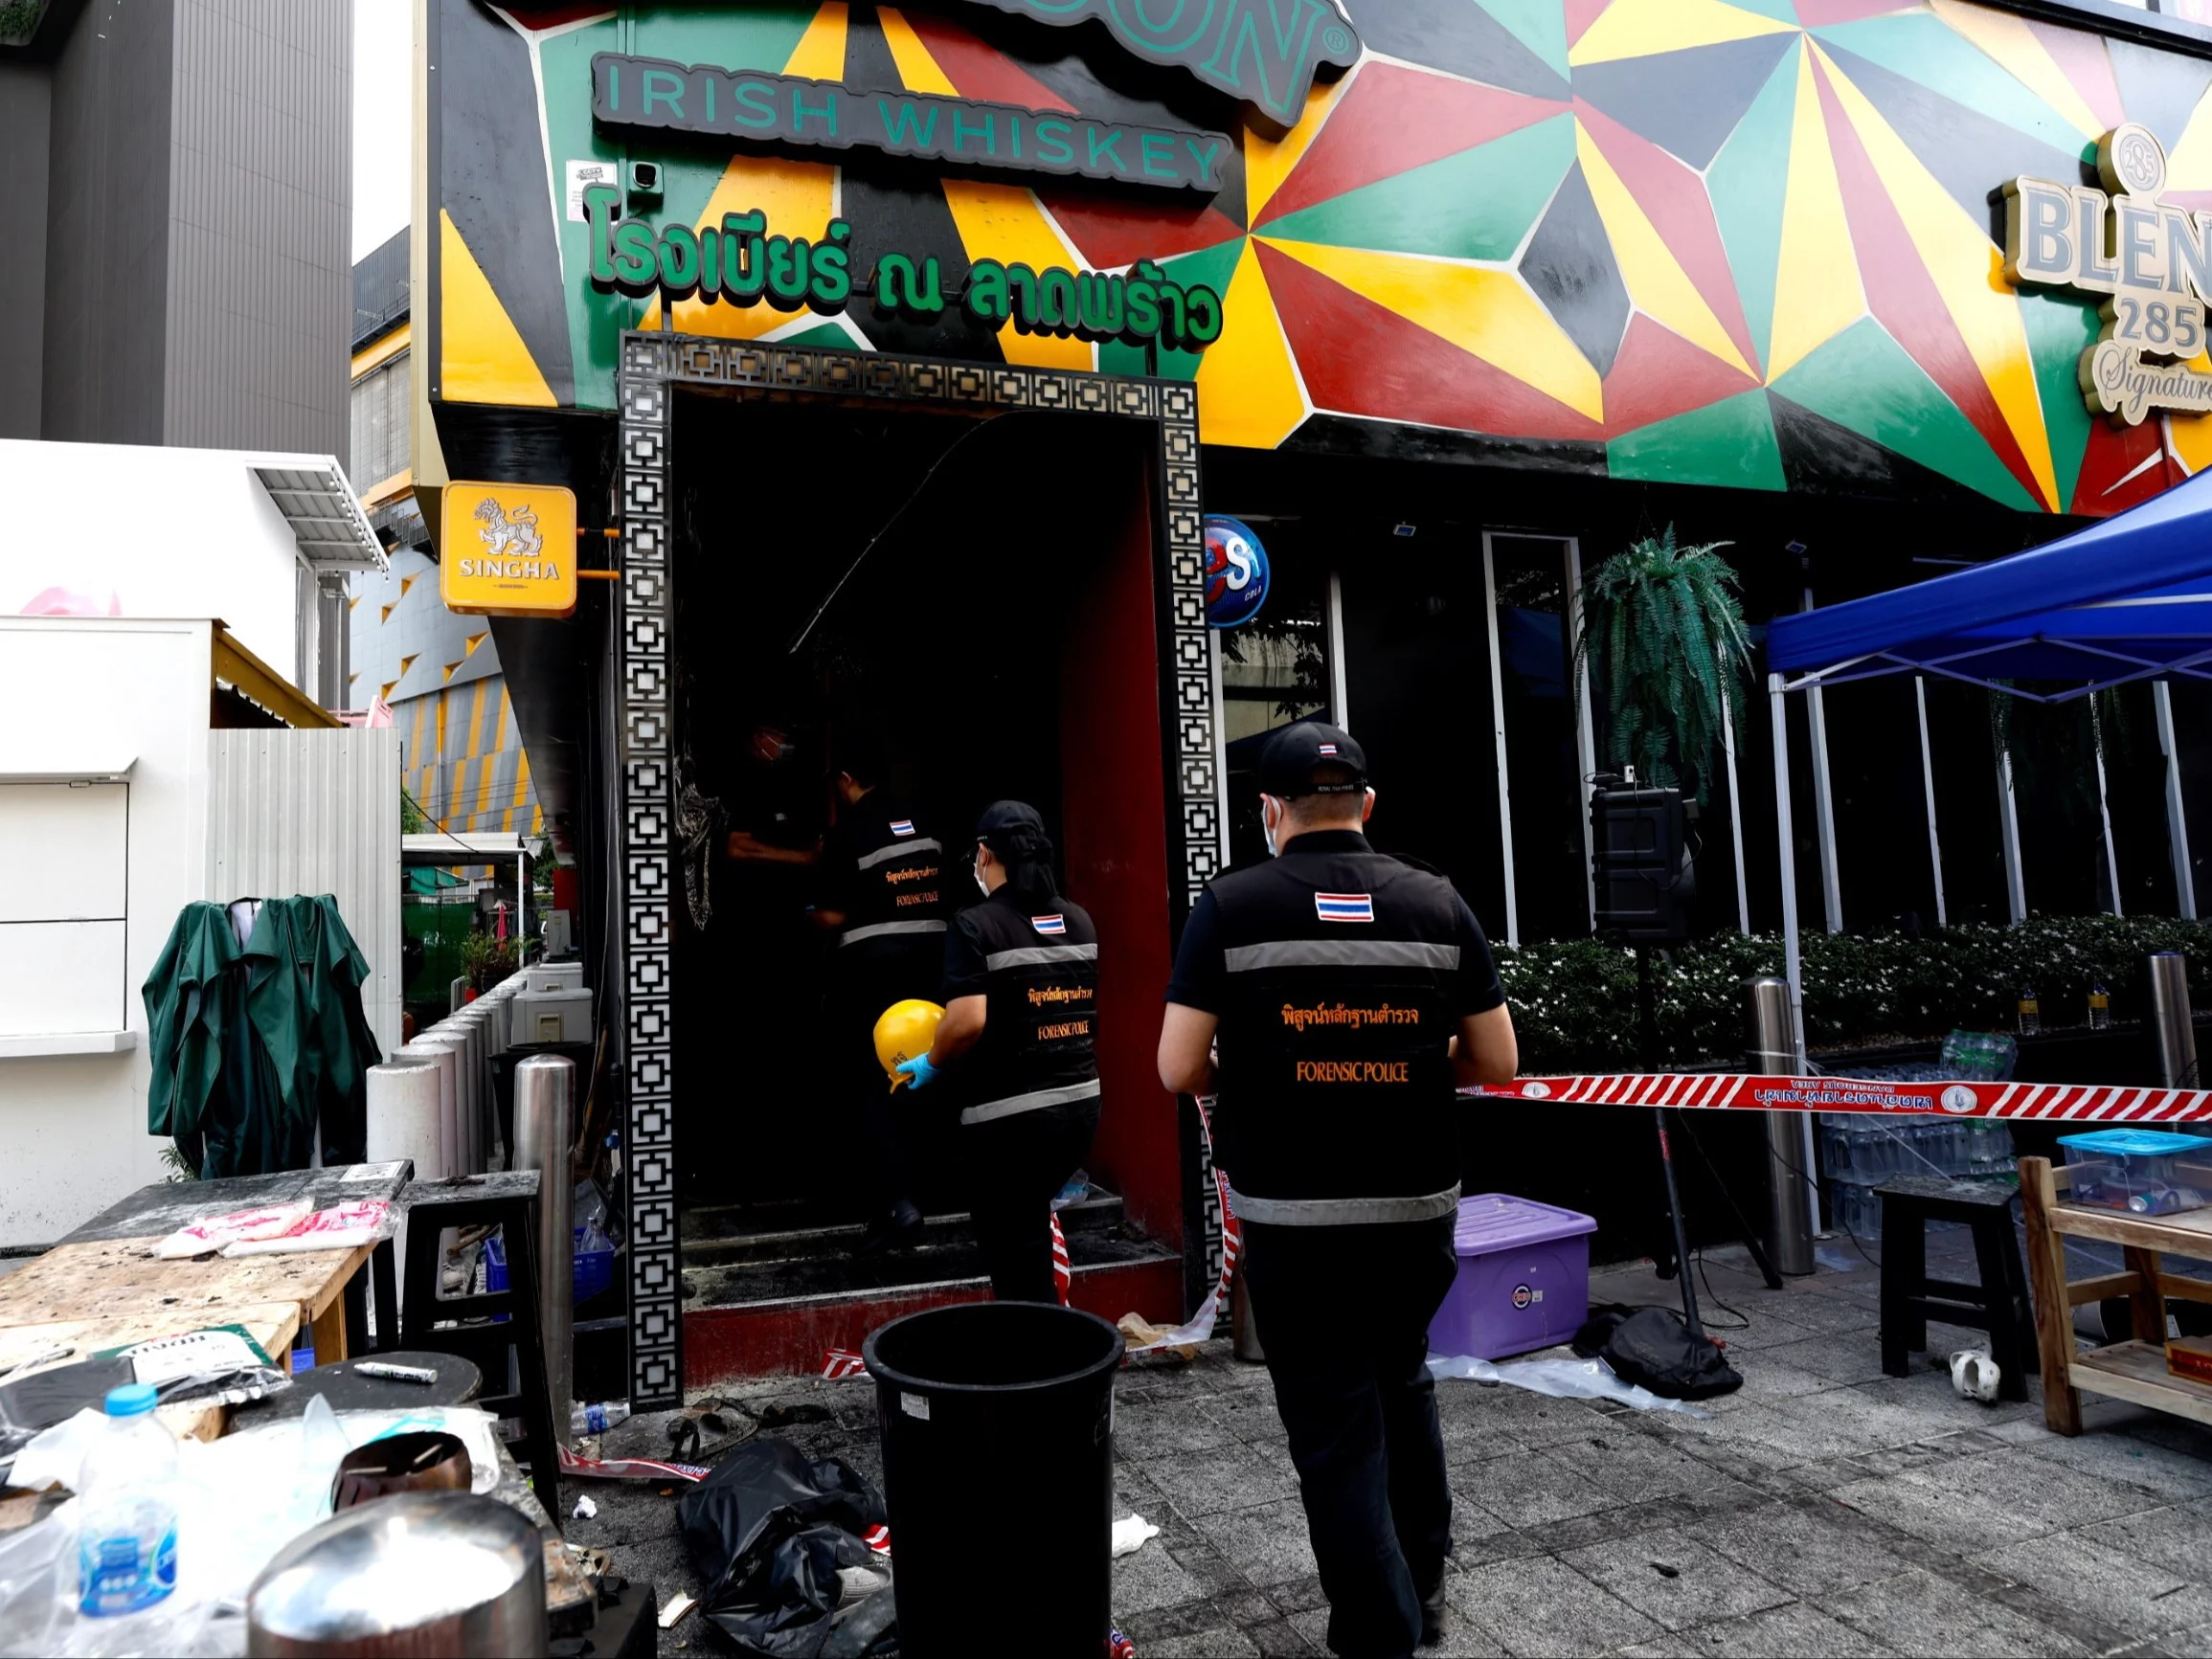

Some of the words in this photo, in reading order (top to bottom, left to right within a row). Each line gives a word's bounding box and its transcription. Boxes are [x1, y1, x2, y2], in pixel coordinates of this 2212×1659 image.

[608, 63, 838, 138] IRISH
[878, 99, 1220, 182] WHISKEY
[583, 183, 851, 303] โรงเบียร์
[877, 253, 945, 313] ณ
[966, 258, 1224, 342] ลาดพร้าว
[2119, 297, 2199, 348] 285
[459, 558, 560, 581] SINGHA
[1244, 585, 1262, 602] COLA
[1281, 1001, 1419, 1032] พิสูจน์หลักฐานตำรวจ
[1297, 1061, 1362, 1083] FORENSIC
[1364, 1062, 1409, 1083] POLICE
